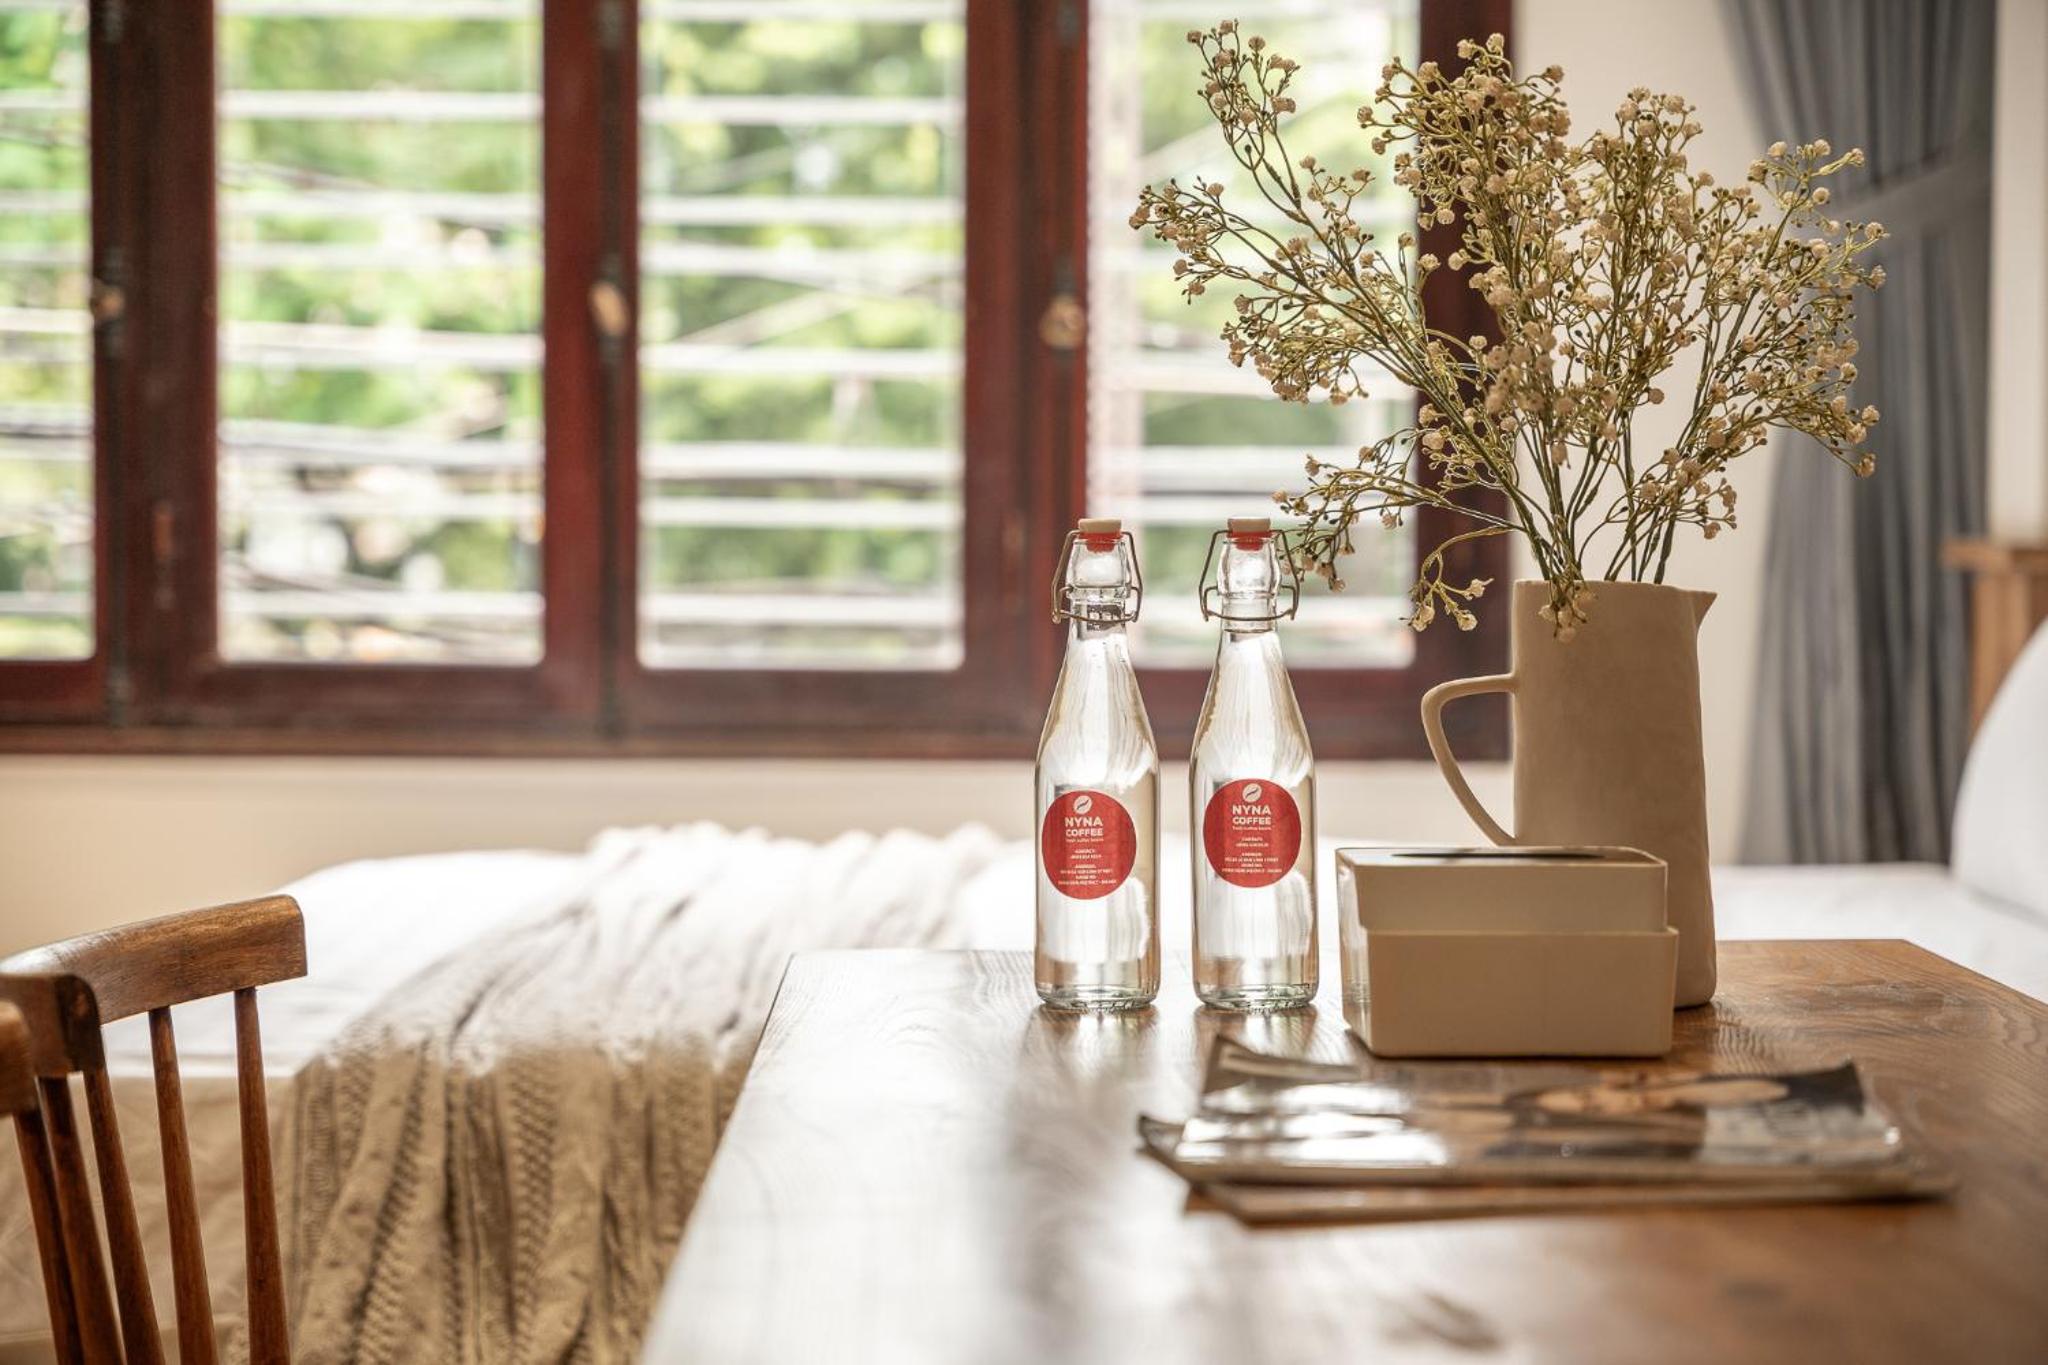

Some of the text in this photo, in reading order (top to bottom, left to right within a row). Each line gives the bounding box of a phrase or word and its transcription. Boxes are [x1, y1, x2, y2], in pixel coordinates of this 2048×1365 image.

[1232, 804, 1272, 815] NYNA
[1064, 816, 1103, 827] NYNA
[1232, 816, 1272, 825] COFFEE
[1065, 828, 1104, 837] COFFEE
